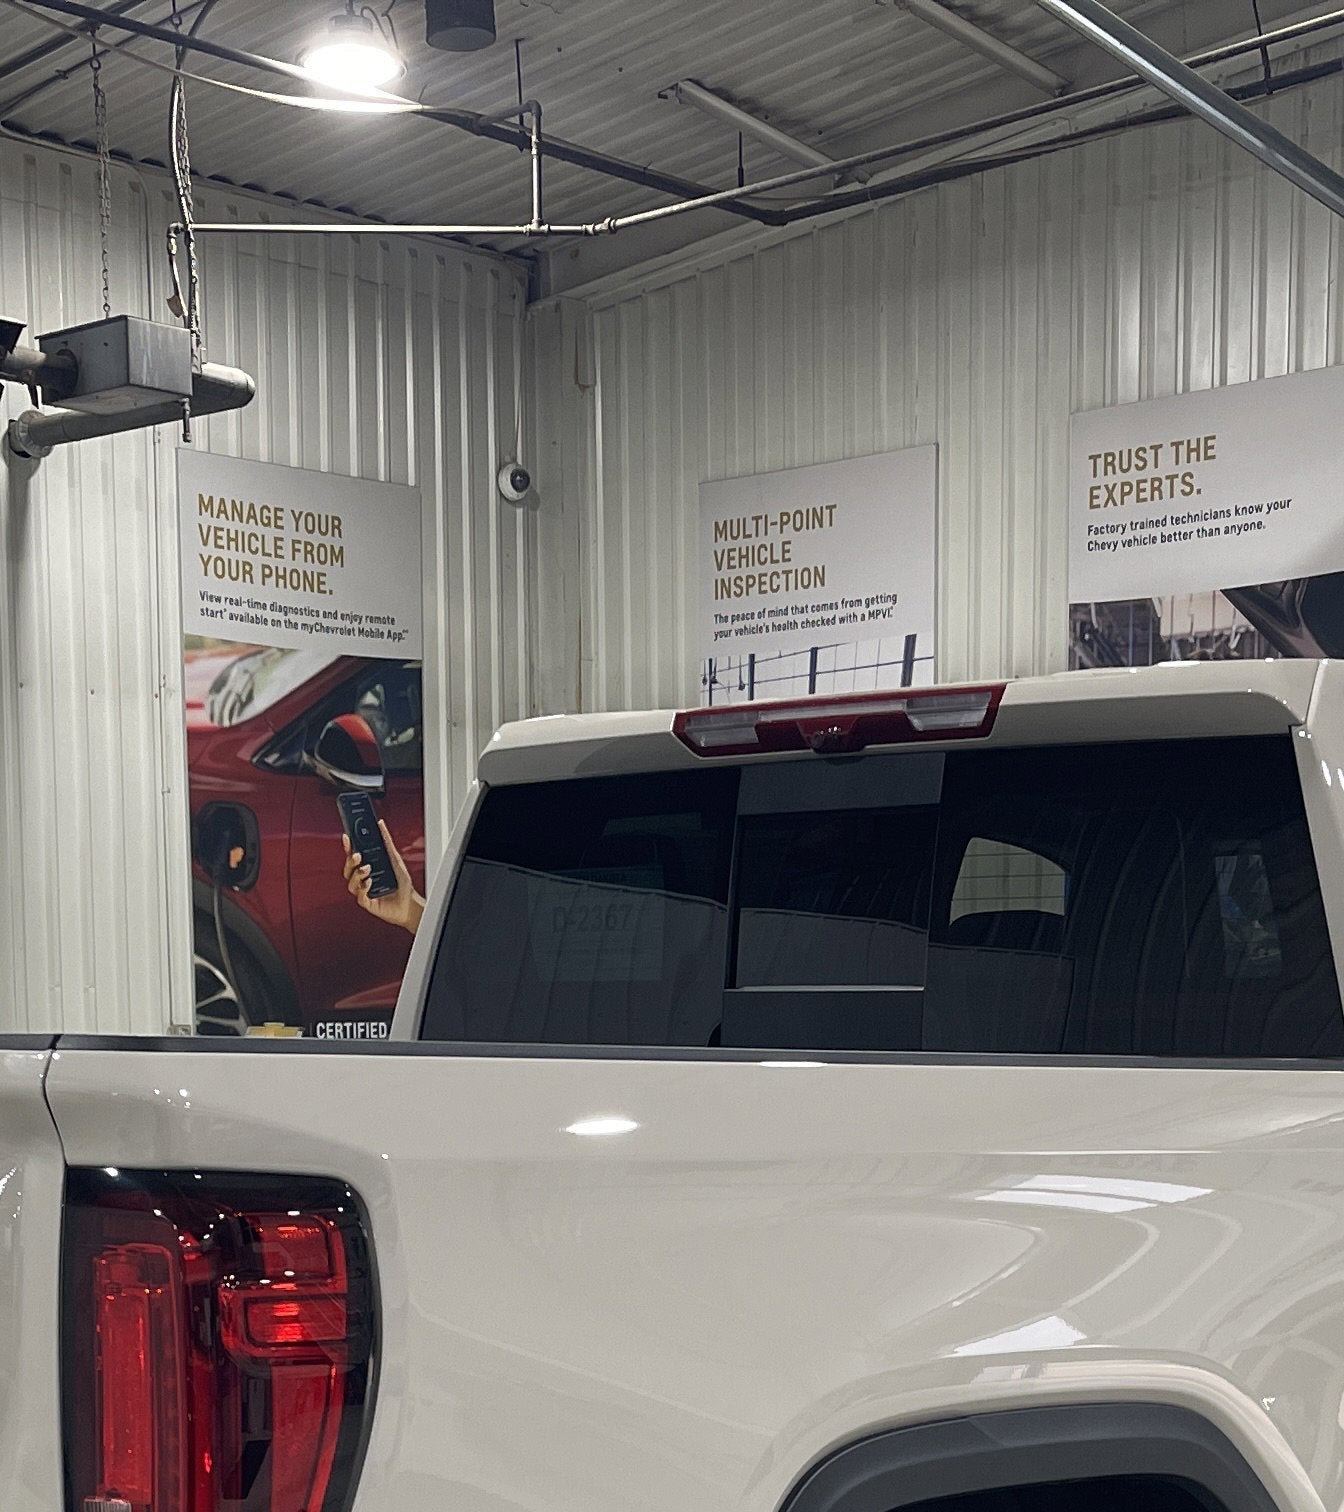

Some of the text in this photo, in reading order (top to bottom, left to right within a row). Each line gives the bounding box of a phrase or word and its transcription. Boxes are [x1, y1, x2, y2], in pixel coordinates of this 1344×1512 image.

[1088, 434, 1217, 478] TRUST THE
[1089, 471, 1202, 510] EXPERTS.
[198, 493, 342, 538] MANAGE YOUR
[714, 504, 837, 543] MULTI-POINT
[1087, 498, 1292, 536] Factory trained technicians know your
[198, 523, 345, 568] VEHICLE FROM
[1087, 519, 1266, 552] Chevy vehicle better than anyone.
[714, 540, 792, 571] VEHICLE
[199, 554, 334, 595] YOUR PHONE.
[715, 565, 826, 600] INSPECTION
[199, 590, 395, 626] View real-time diagnostics and enjoy remote
[229, 612, 268, 626] available
[271, 619, 282, 629] on
[284, 619, 298, 630] the
[301, 621, 356, 637] myChevrolet
[358, 627, 384, 639] Mobile
[714, 593, 897, 625] The peace of mind that comes from getting
[714, 630, 732, 642] your
[735, 622, 769, 636] vehicle's
[772, 620, 798, 632] health
[801, 614, 836, 629] checked
[839, 612, 858, 624] with
[860, 613, 866, 621] a
[316, 1022, 387, 1039] CERTIFIED
